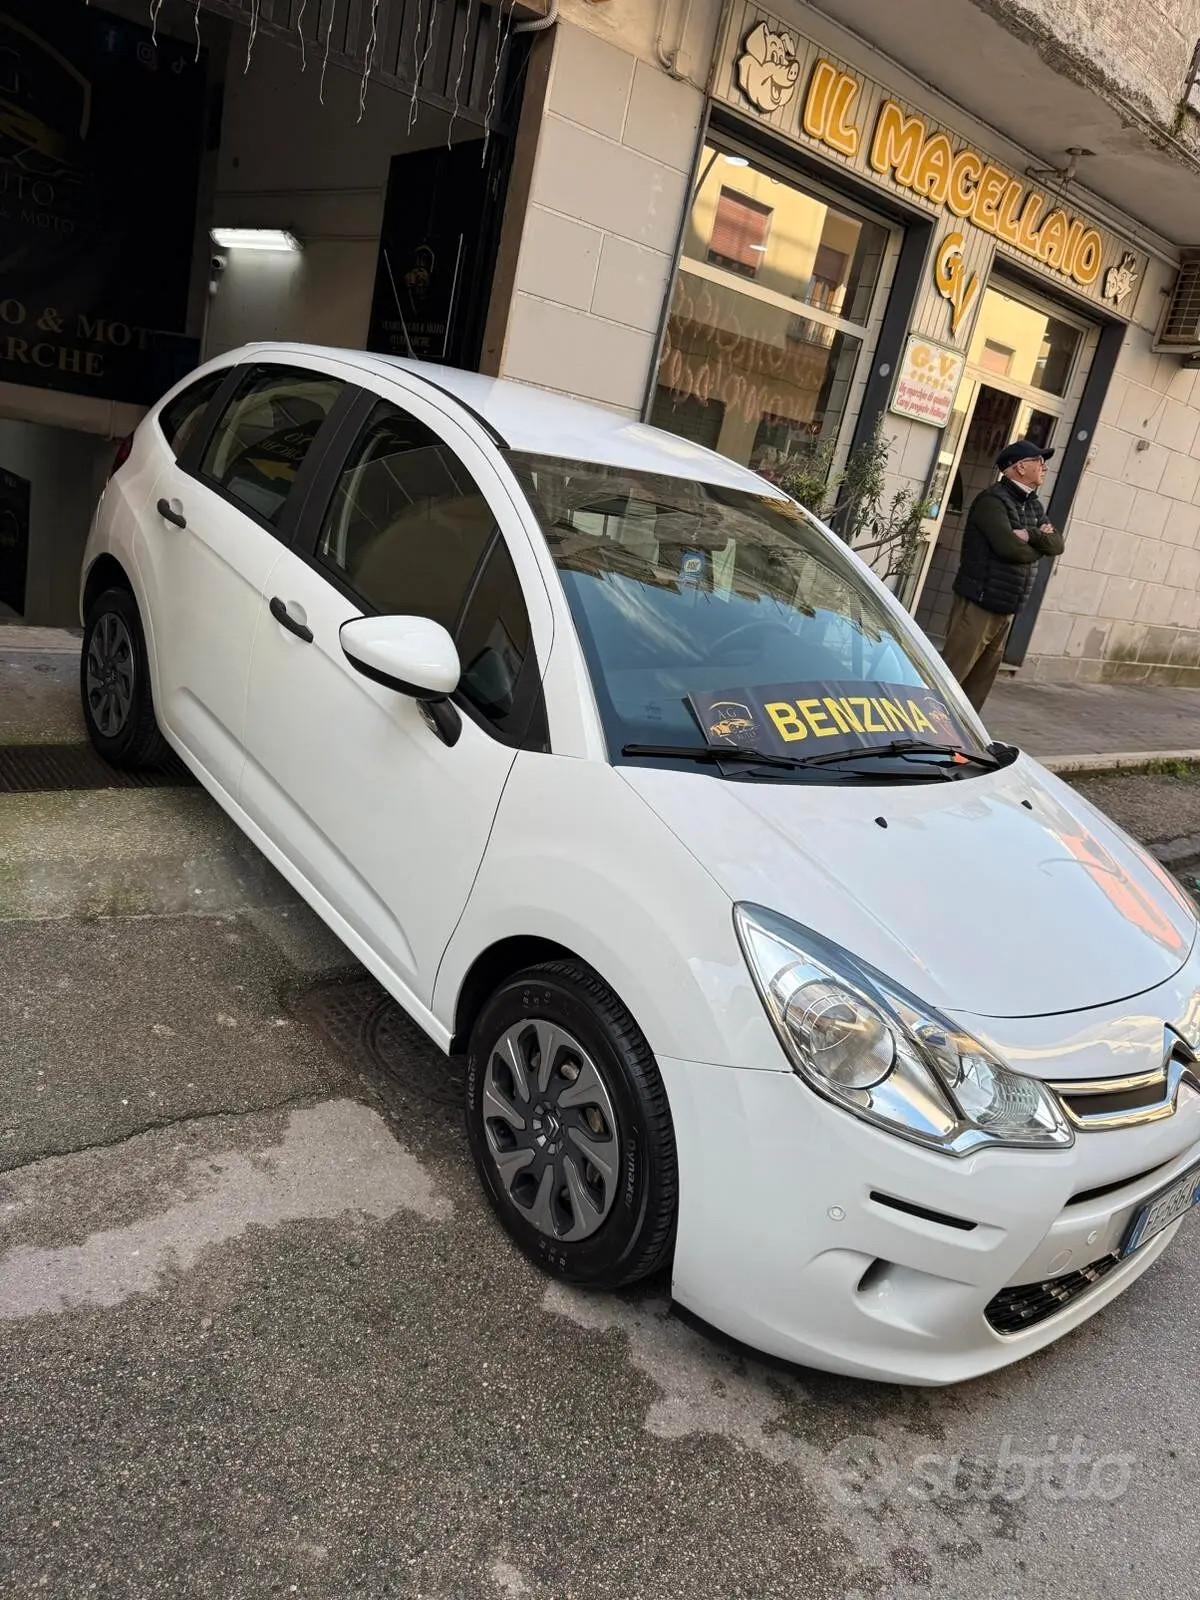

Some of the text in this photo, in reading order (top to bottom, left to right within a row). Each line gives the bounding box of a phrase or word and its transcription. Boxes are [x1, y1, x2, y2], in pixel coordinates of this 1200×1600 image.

[804, 59, 1102, 286] IL MACELLAIO
[36, 306, 65, 334] &
[0, 336, 105, 377] RCHE
[764, 697, 938, 742] BENZINA
